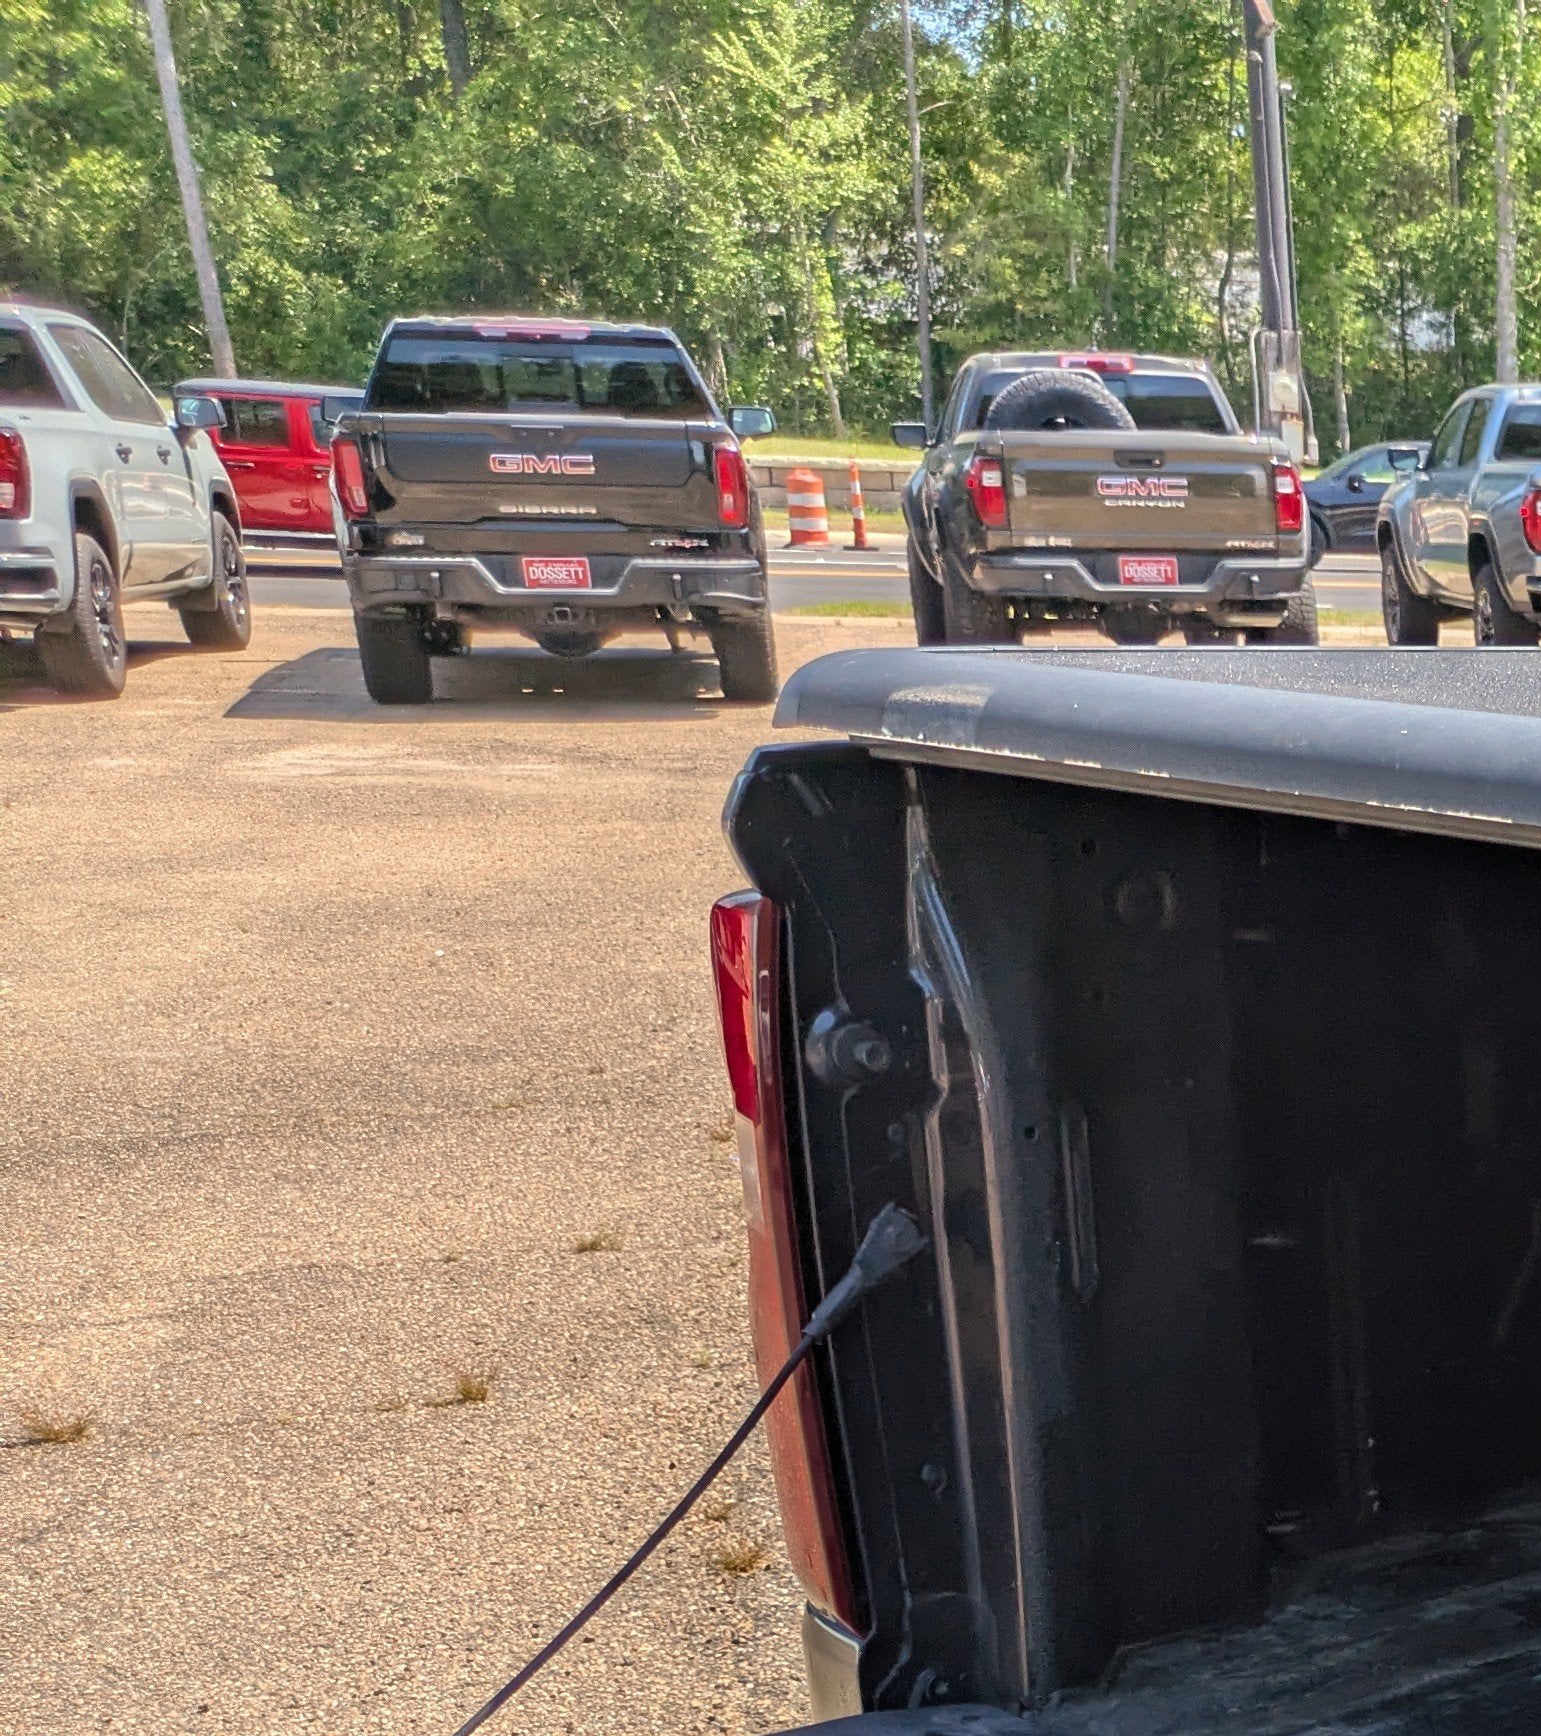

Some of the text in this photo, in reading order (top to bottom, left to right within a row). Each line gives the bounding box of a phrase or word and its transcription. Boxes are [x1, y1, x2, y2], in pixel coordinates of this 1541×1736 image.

[489, 453, 596, 475] GMC
[1096, 475, 1189, 497] GMC
[528, 566, 584, 580] DOSSETT
